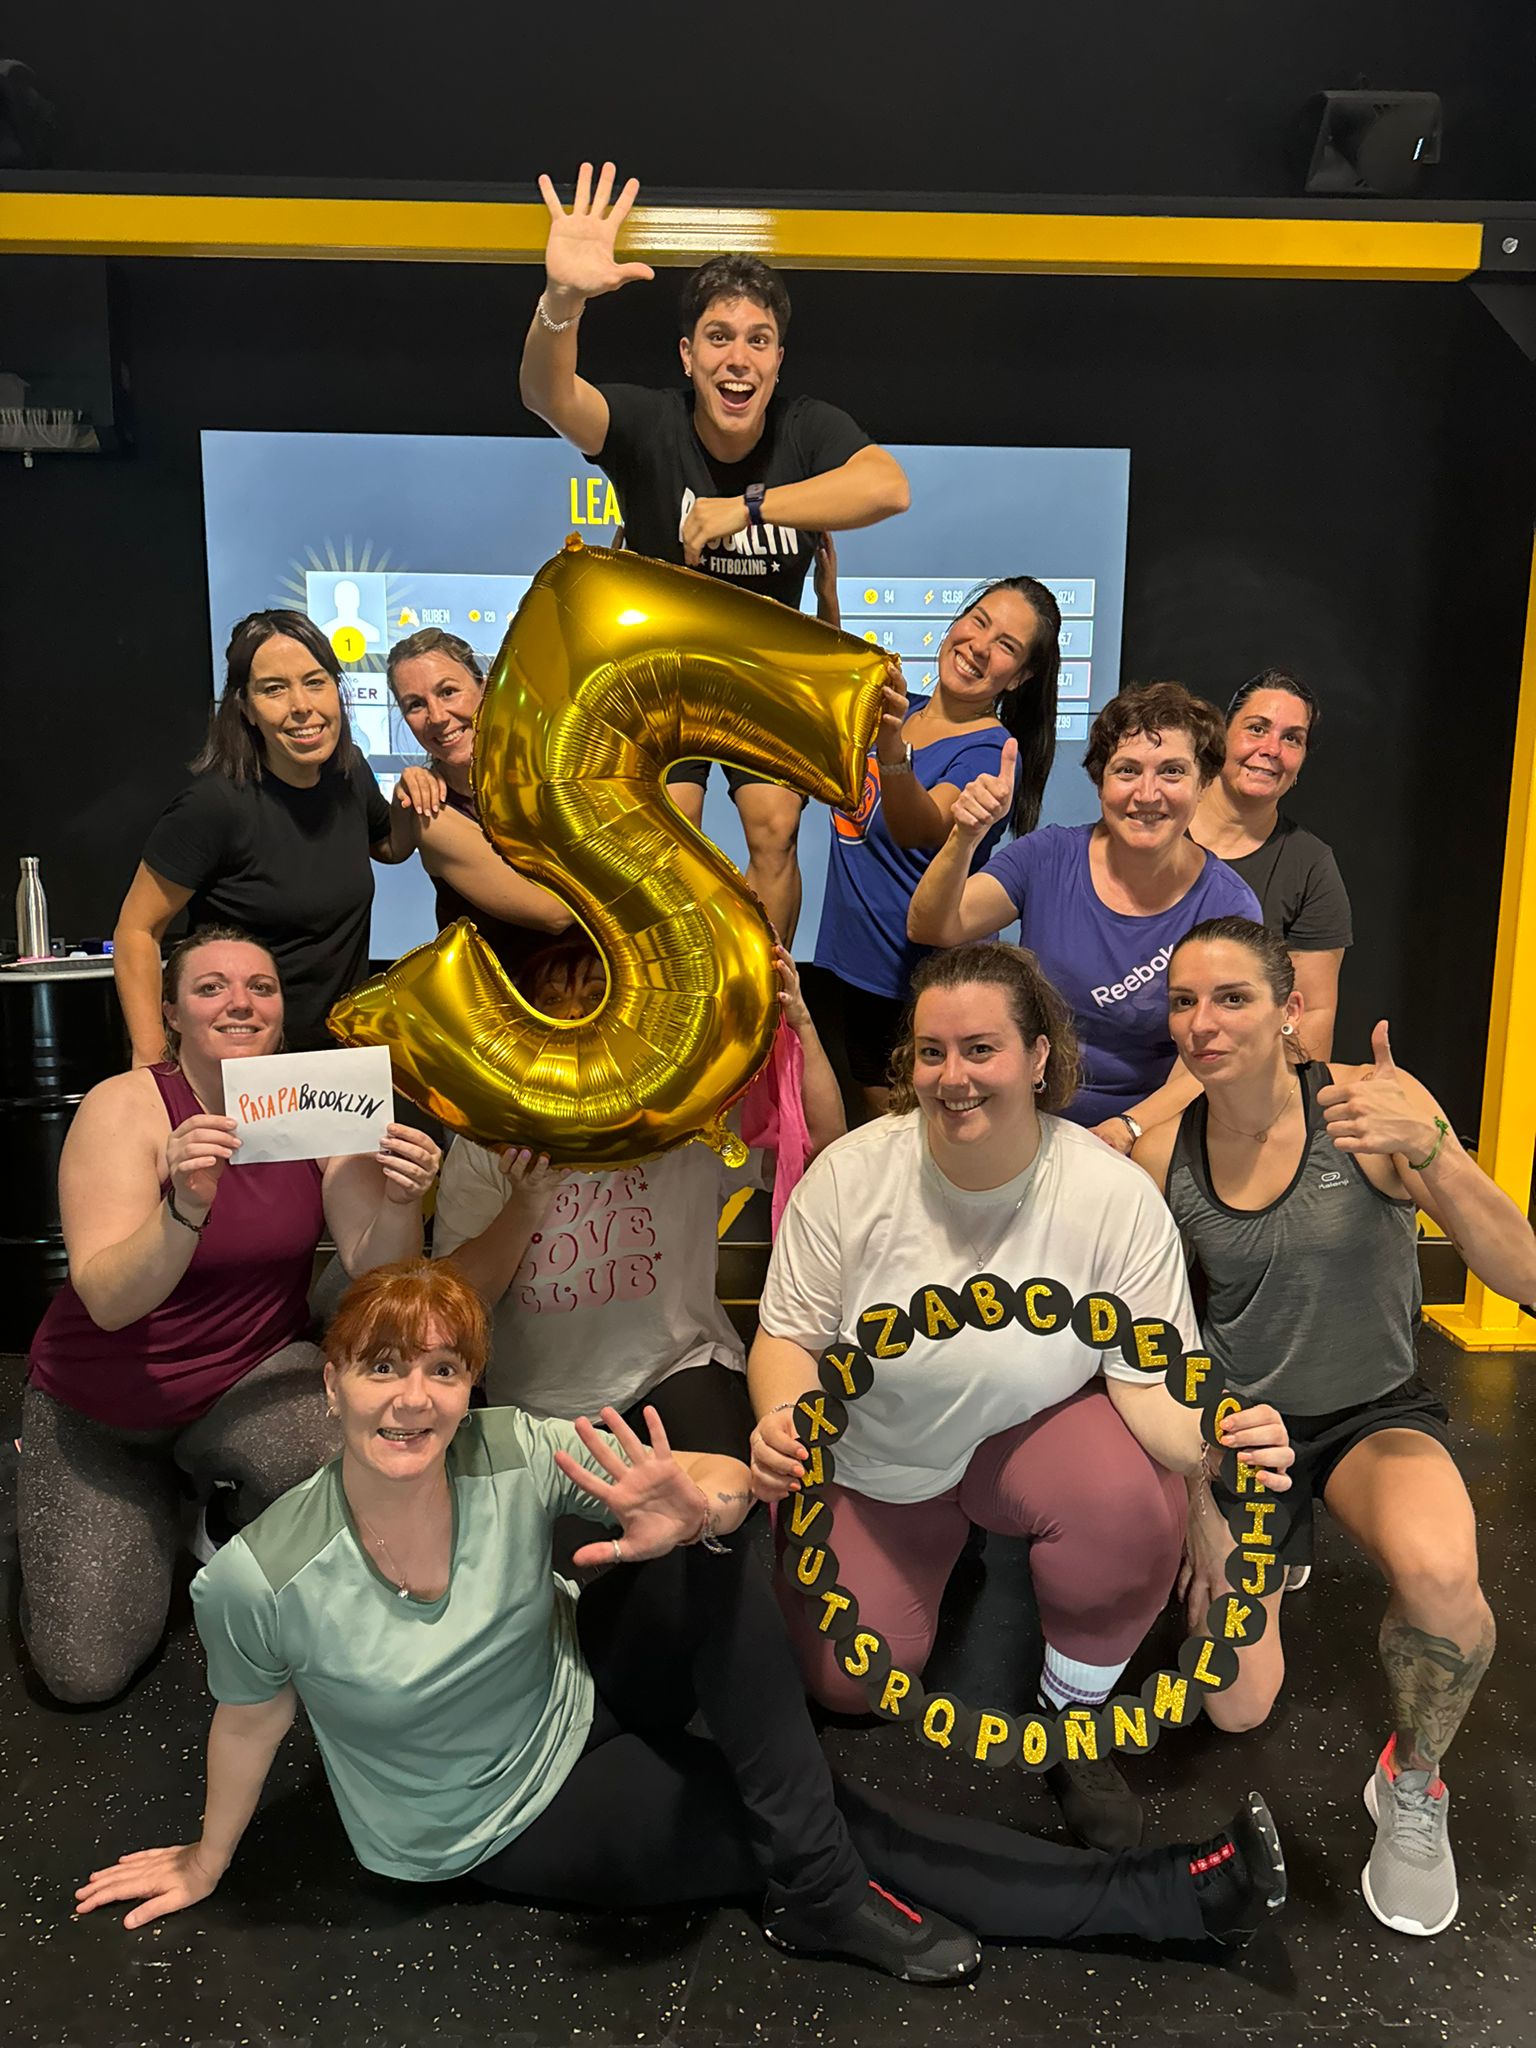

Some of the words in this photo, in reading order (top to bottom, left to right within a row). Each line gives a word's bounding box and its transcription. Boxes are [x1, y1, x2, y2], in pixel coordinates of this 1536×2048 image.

[710, 556, 767, 576] FITBOXING
[422, 609, 451, 624] RUBEN
[884, 589, 895, 603] 94
[344, 637, 352, 652] 1
[883, 632, 894, 646] 94
[925, 1290, 959, 1336] A
[970, 1280, 1005, 1325] B
[1025, 1284, 1057, 1329] C
[1088, 1298, 1118, 1343] D
[861, 1308, 909, 1358] Z
[1133, 1323, 1168, 1367] E
[825, 1352, 857, 1395] Y
[1185, 1357, 1212, 1401] F
[799, 1397, 838, 1441] X
[791, 1492, 824, 1536] V
[1241, 1502, 1276, 1545] I
[798, 1546, 826, 1585] U
[1241, 1552, 1276, 1595] J
[818, 1591, 851, 1632] T
[1223, 1597, 1252, 1639] K
[844, 1632, 880, 1676] S
[1193, 1640, 1222, 1687] L
[879, 1670, 911, 1715] R
[1153, 1673, 1189, 1723] M
[923, 1697, 955, 1748] Q
[974, 1714, 1008, 1760] P
[1022, 1720, 1047, 1764] O
[1064, 1711, 1099, 1760] Ñ
[1113, 1706, 1149, 1748] N
